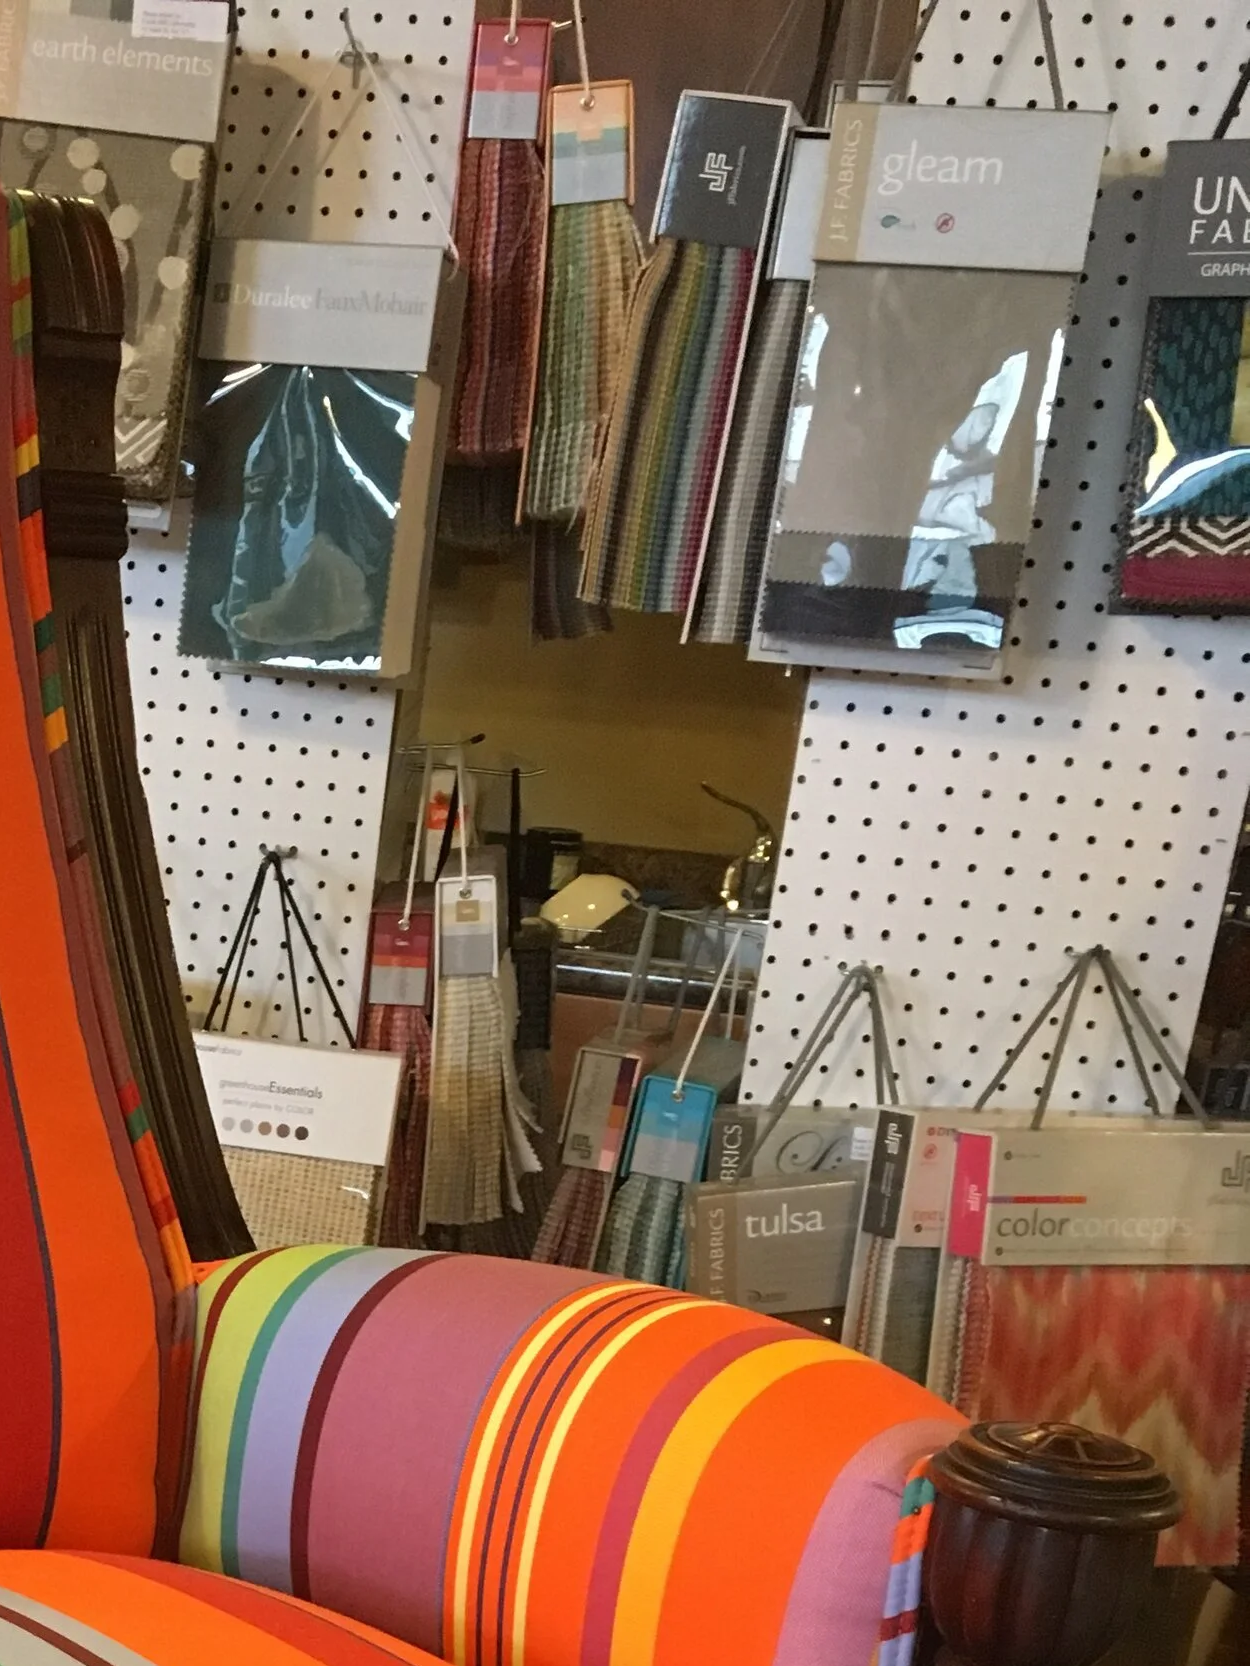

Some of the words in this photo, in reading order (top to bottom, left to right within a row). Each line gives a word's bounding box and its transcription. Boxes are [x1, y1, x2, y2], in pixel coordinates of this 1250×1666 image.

[32, 35, 96, 63] earth
[102, 38, 213, 77] elements
[834, 119, 864, 203] FABRICS
[877, 139, 1004, 196] gleam
[233, 283, 312, 310] Duralee
[745, 1203, 825, 1238] tulsa
[996, 1207, 1193, 1246] colorconcepts
[709, 1208, 725, 1281] FABRICS
